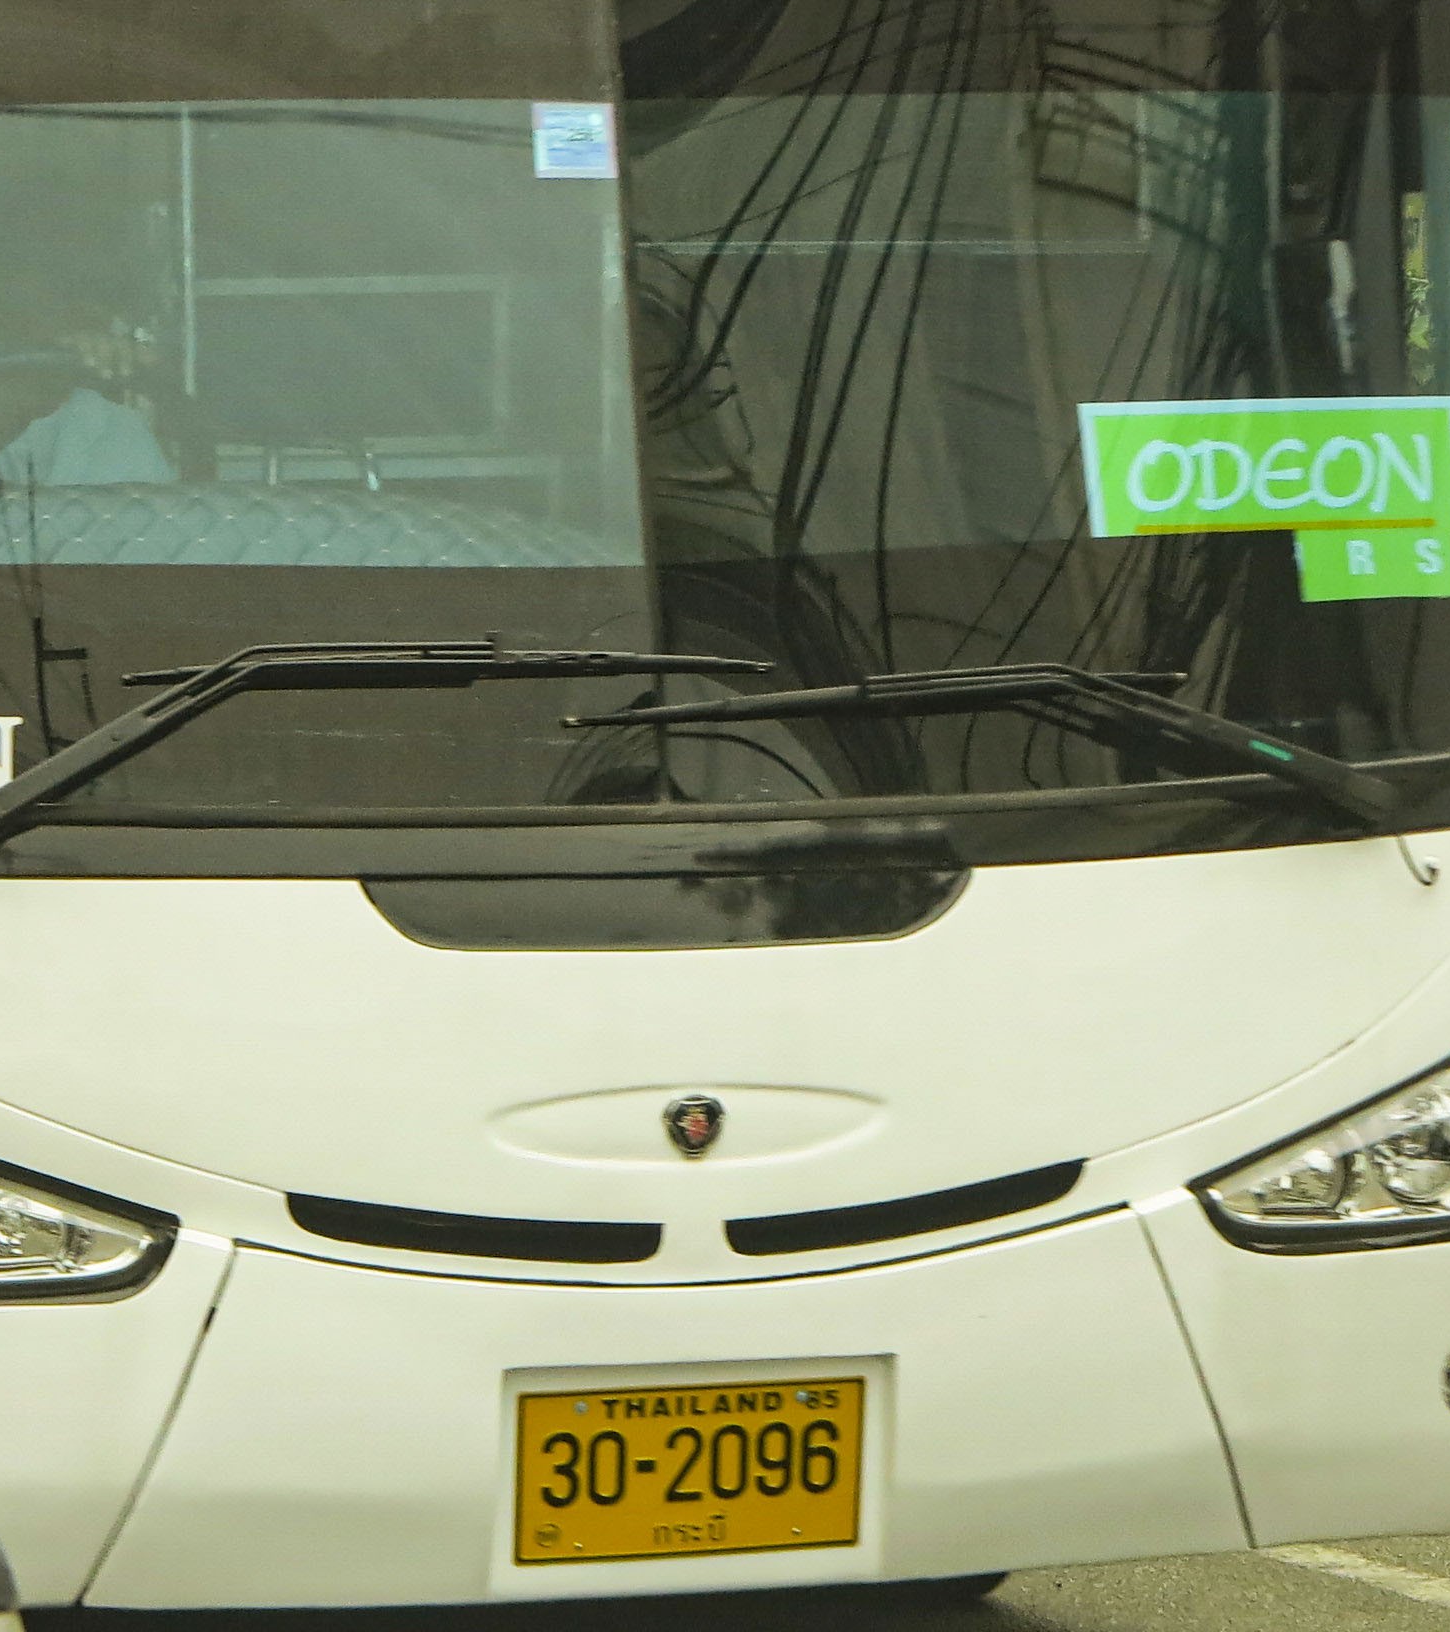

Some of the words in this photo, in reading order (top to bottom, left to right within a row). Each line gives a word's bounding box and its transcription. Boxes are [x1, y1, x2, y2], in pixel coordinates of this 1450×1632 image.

[1126, 432, 1434, 513] ODEON
[602, 1391, 784, 1421] THAILAND
[540, 1418, 841, 1509] 30-2096
